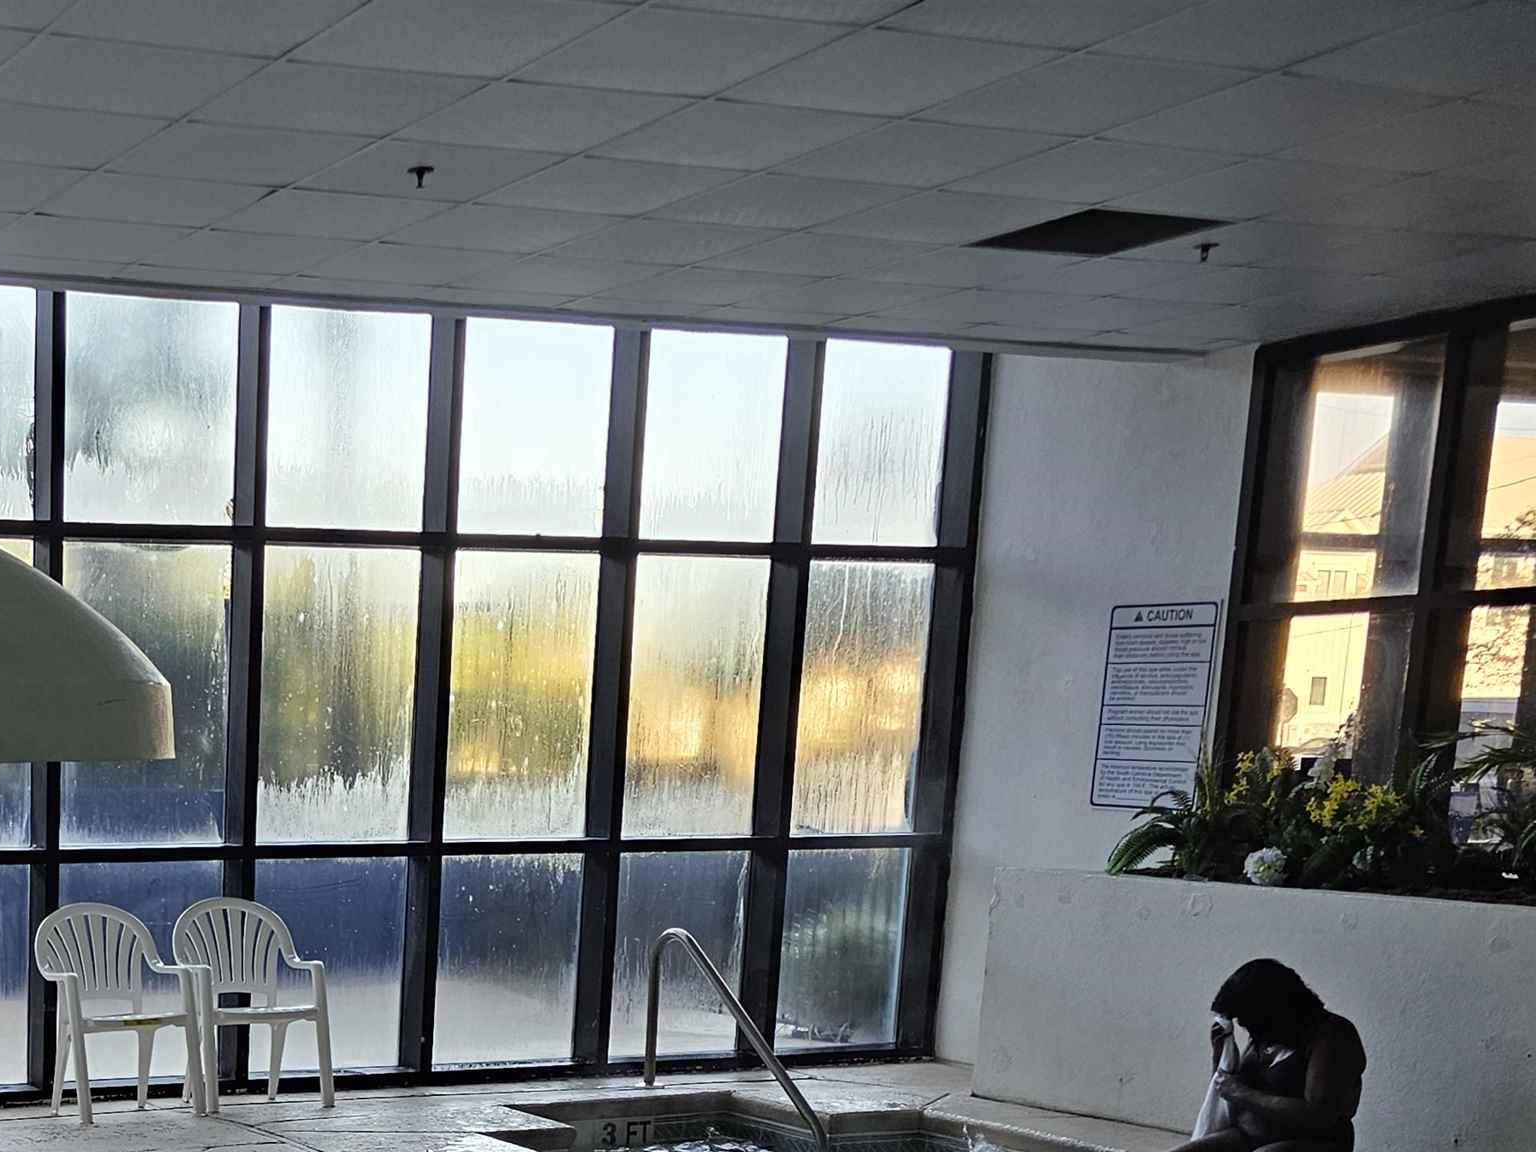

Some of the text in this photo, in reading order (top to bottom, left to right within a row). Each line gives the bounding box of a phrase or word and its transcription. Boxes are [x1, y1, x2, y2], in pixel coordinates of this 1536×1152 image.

[1147, 608, 1193, 622] CAUTION
[602, 1120, 652, 1146] 3 FT
